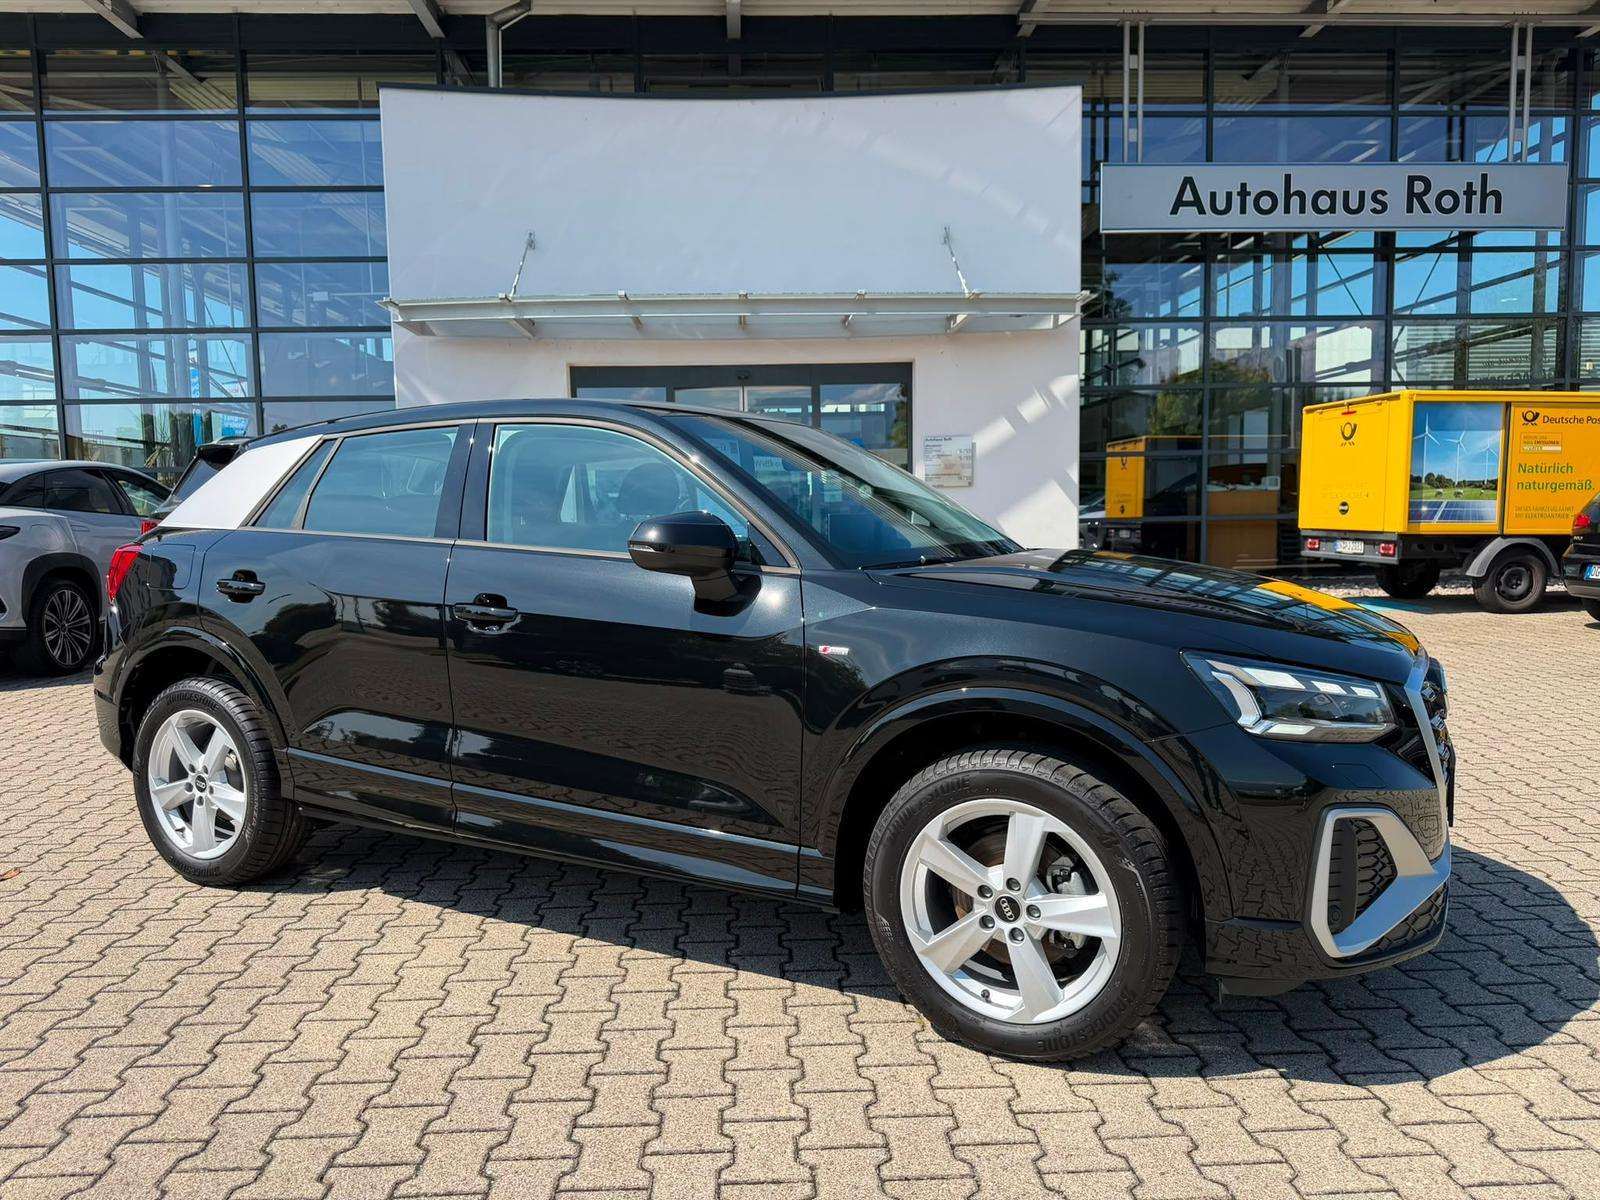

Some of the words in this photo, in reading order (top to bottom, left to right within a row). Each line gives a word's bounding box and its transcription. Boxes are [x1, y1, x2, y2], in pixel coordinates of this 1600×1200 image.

[1169, 173, 1388, 216] Autohaus
[1405, 173, 1503, 215] Roth
[1542, 415, 1584, 425] Deutsche
[1517, 463, 1574, 474] Natürlich
[1516, 480, 1595, 493] naturgemäß.
